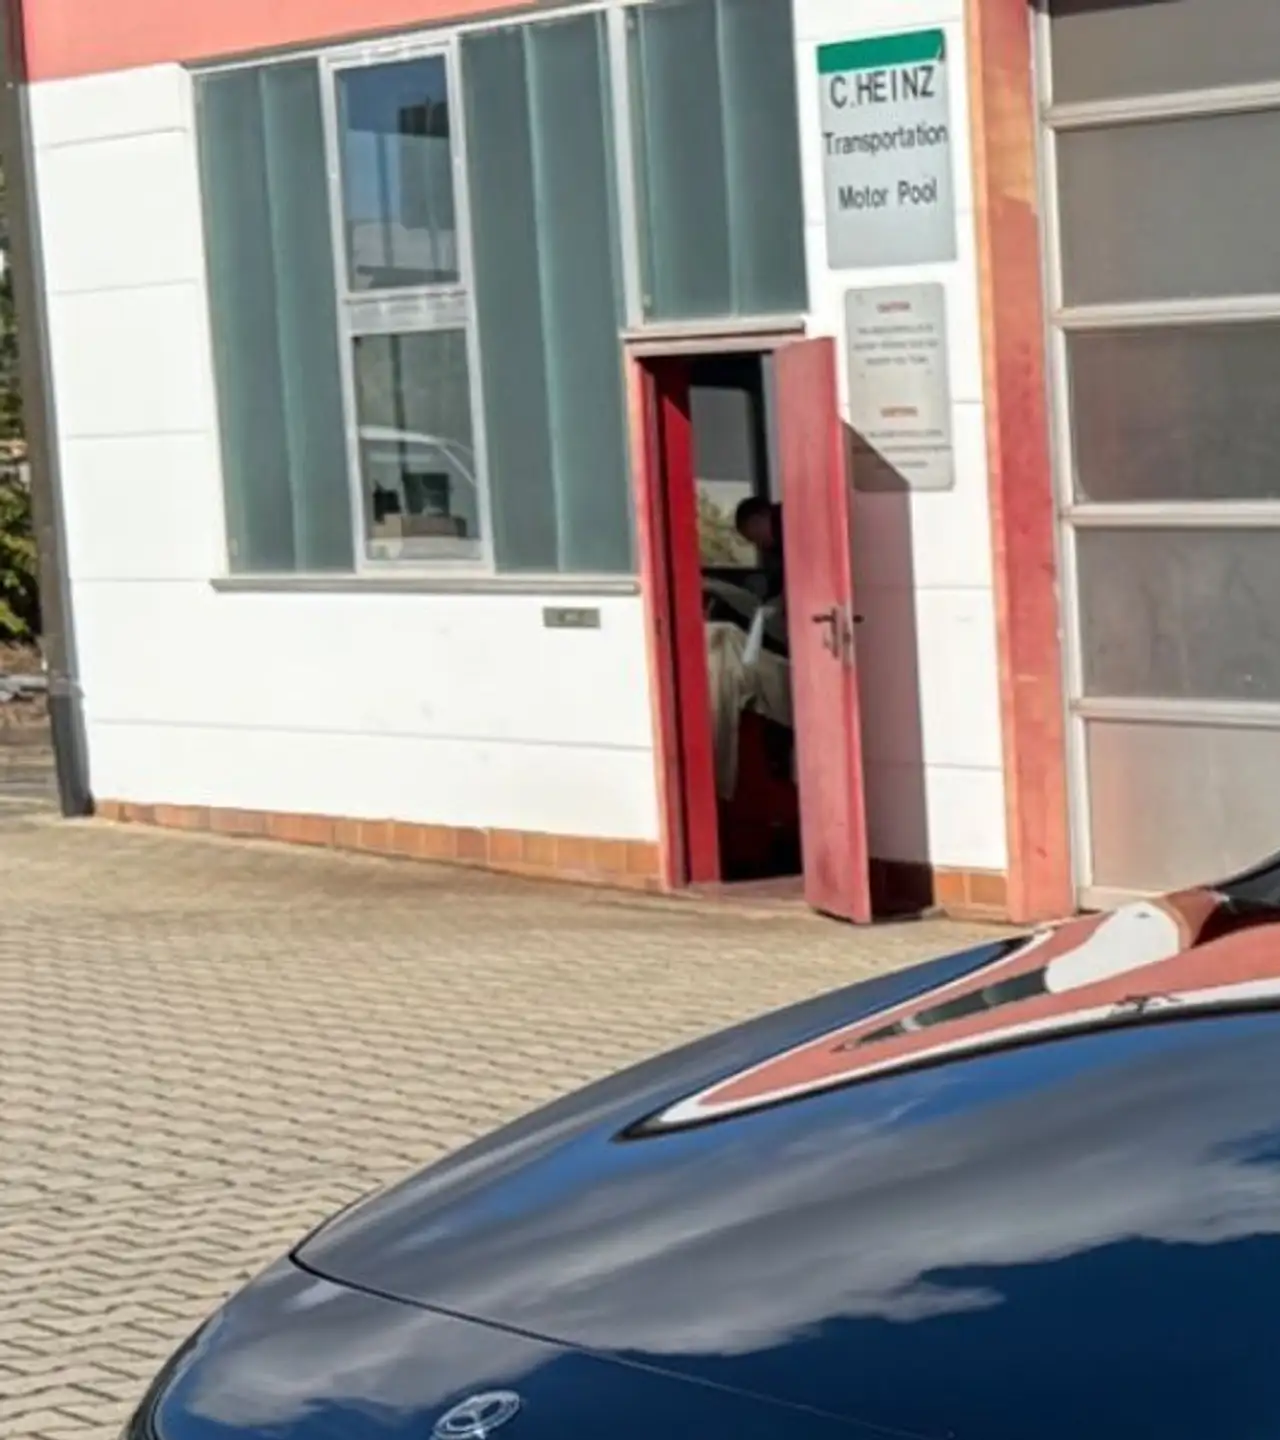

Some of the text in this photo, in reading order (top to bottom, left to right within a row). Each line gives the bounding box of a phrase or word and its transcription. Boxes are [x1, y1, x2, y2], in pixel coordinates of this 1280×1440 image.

[823, 122, 948, 156] Transportation
[838, 176, 937, 211] Motor Pool
